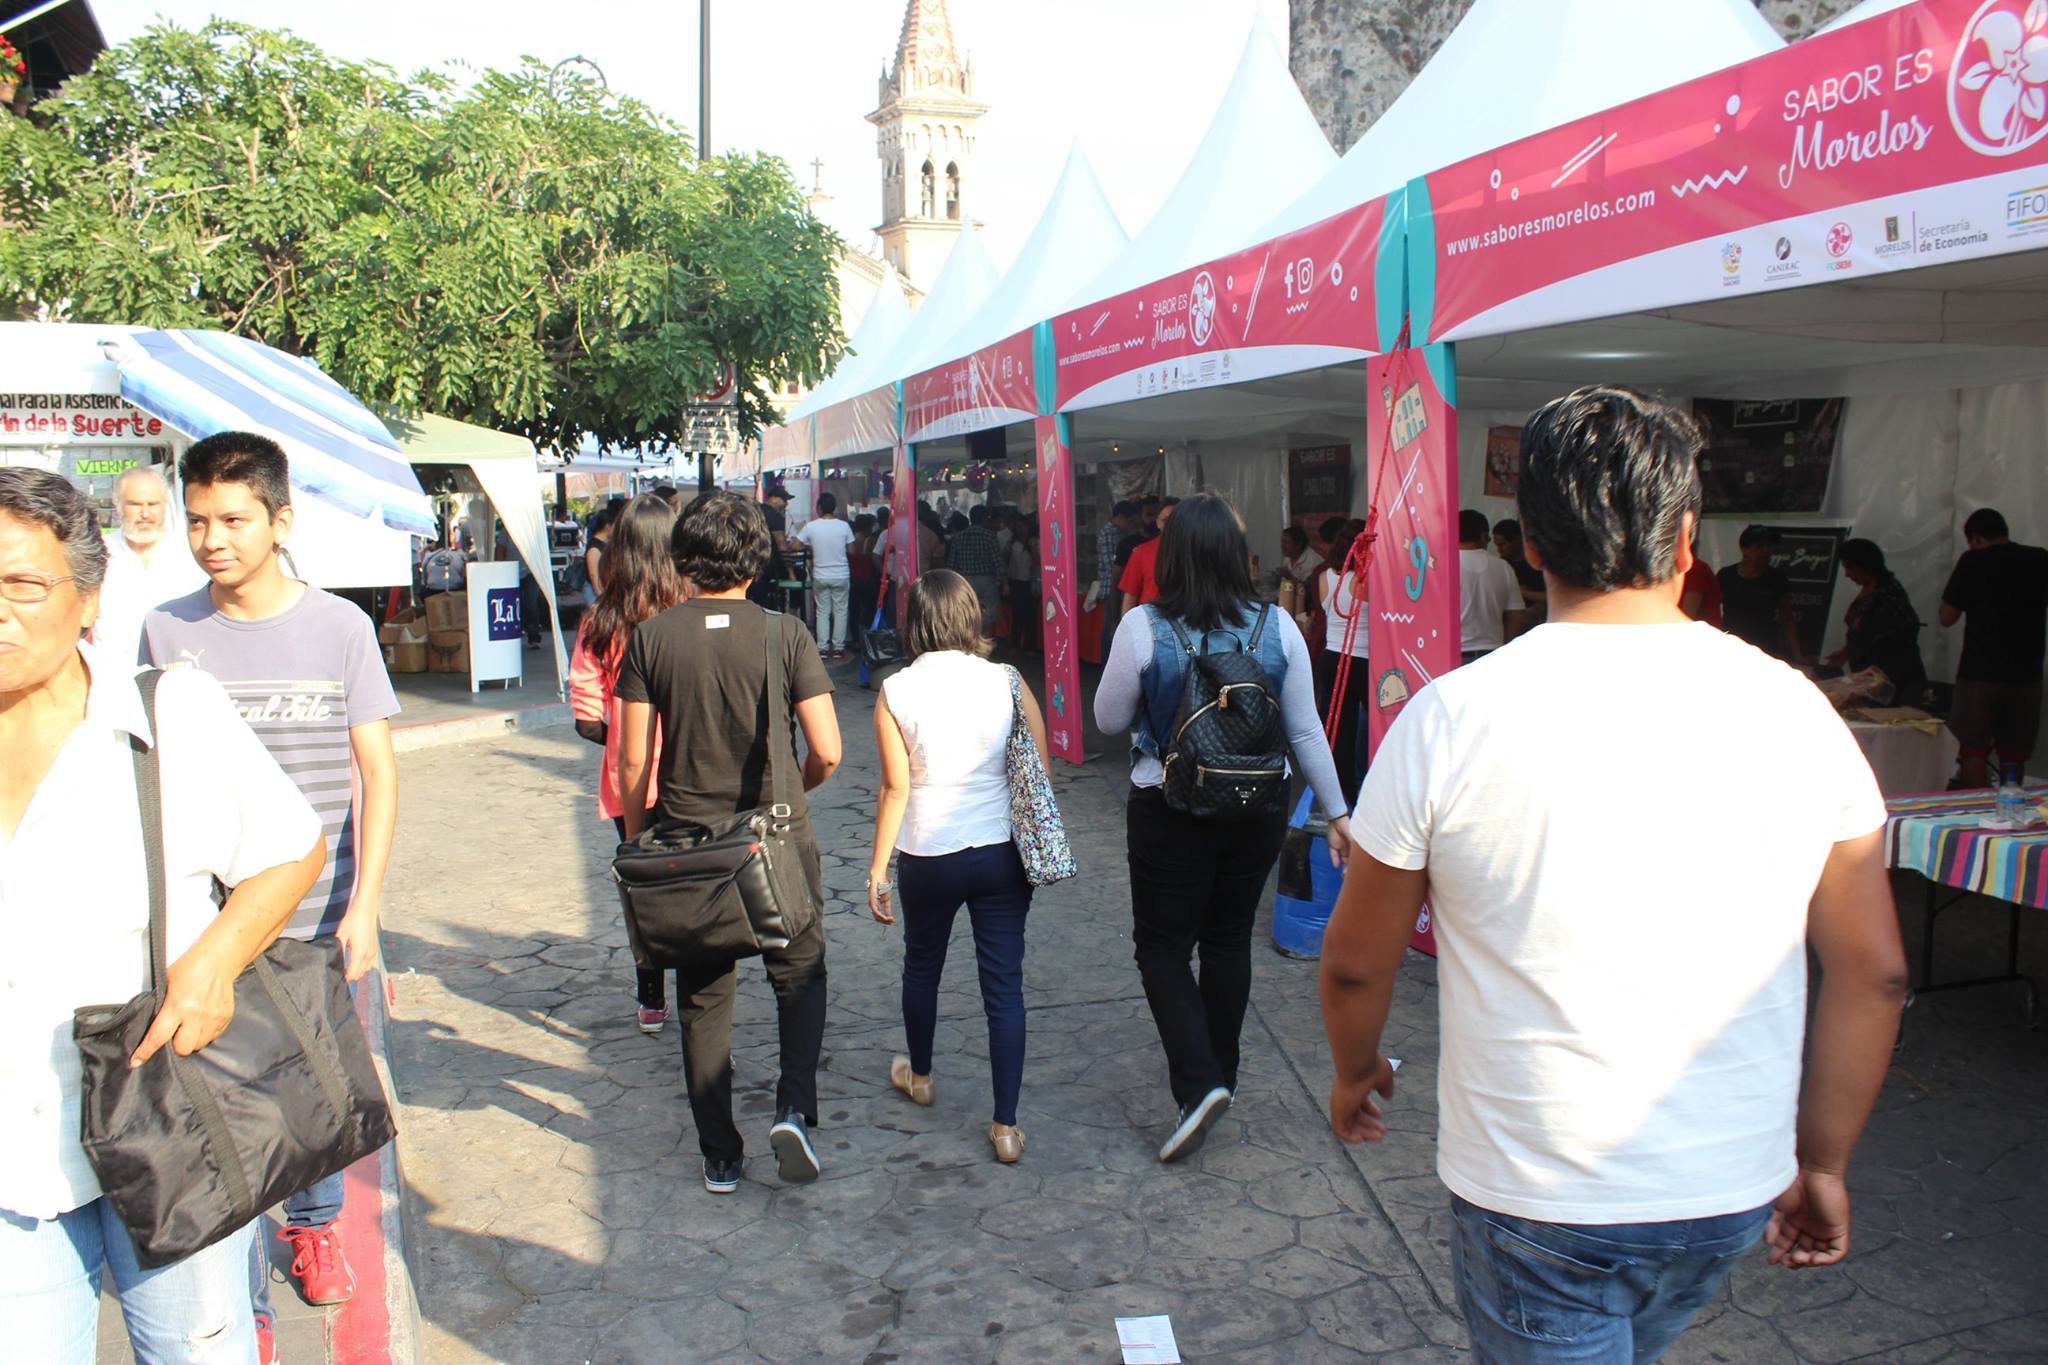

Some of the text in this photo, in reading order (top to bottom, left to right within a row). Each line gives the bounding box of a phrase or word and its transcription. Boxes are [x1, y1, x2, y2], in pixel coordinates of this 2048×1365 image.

[1783, 49, 1933, 121] SABOR ES
[1778, 109, 1934, 189] Morelos
[2006, 193, 2048, 220] FIFO
[1446, 190, 1656, 256] www.saboresmorelos.com
[1874, 240, 1911, 255] MORELOS
[1919, 240, 1933, 252] de
[1935, 230, 1988, 250] Economía
[1152, 293, 1188, 318] SABOR ES
[1151, 318, 1186, 350] Morelos
[1059, 342, 1121, 367] www.saboresmorelos.com
[25, 413, 49, 431] de
[52, 412, 68, 432] la
[72, 411, 162, 437] Suerte
[490, 598, 514, 624] La
